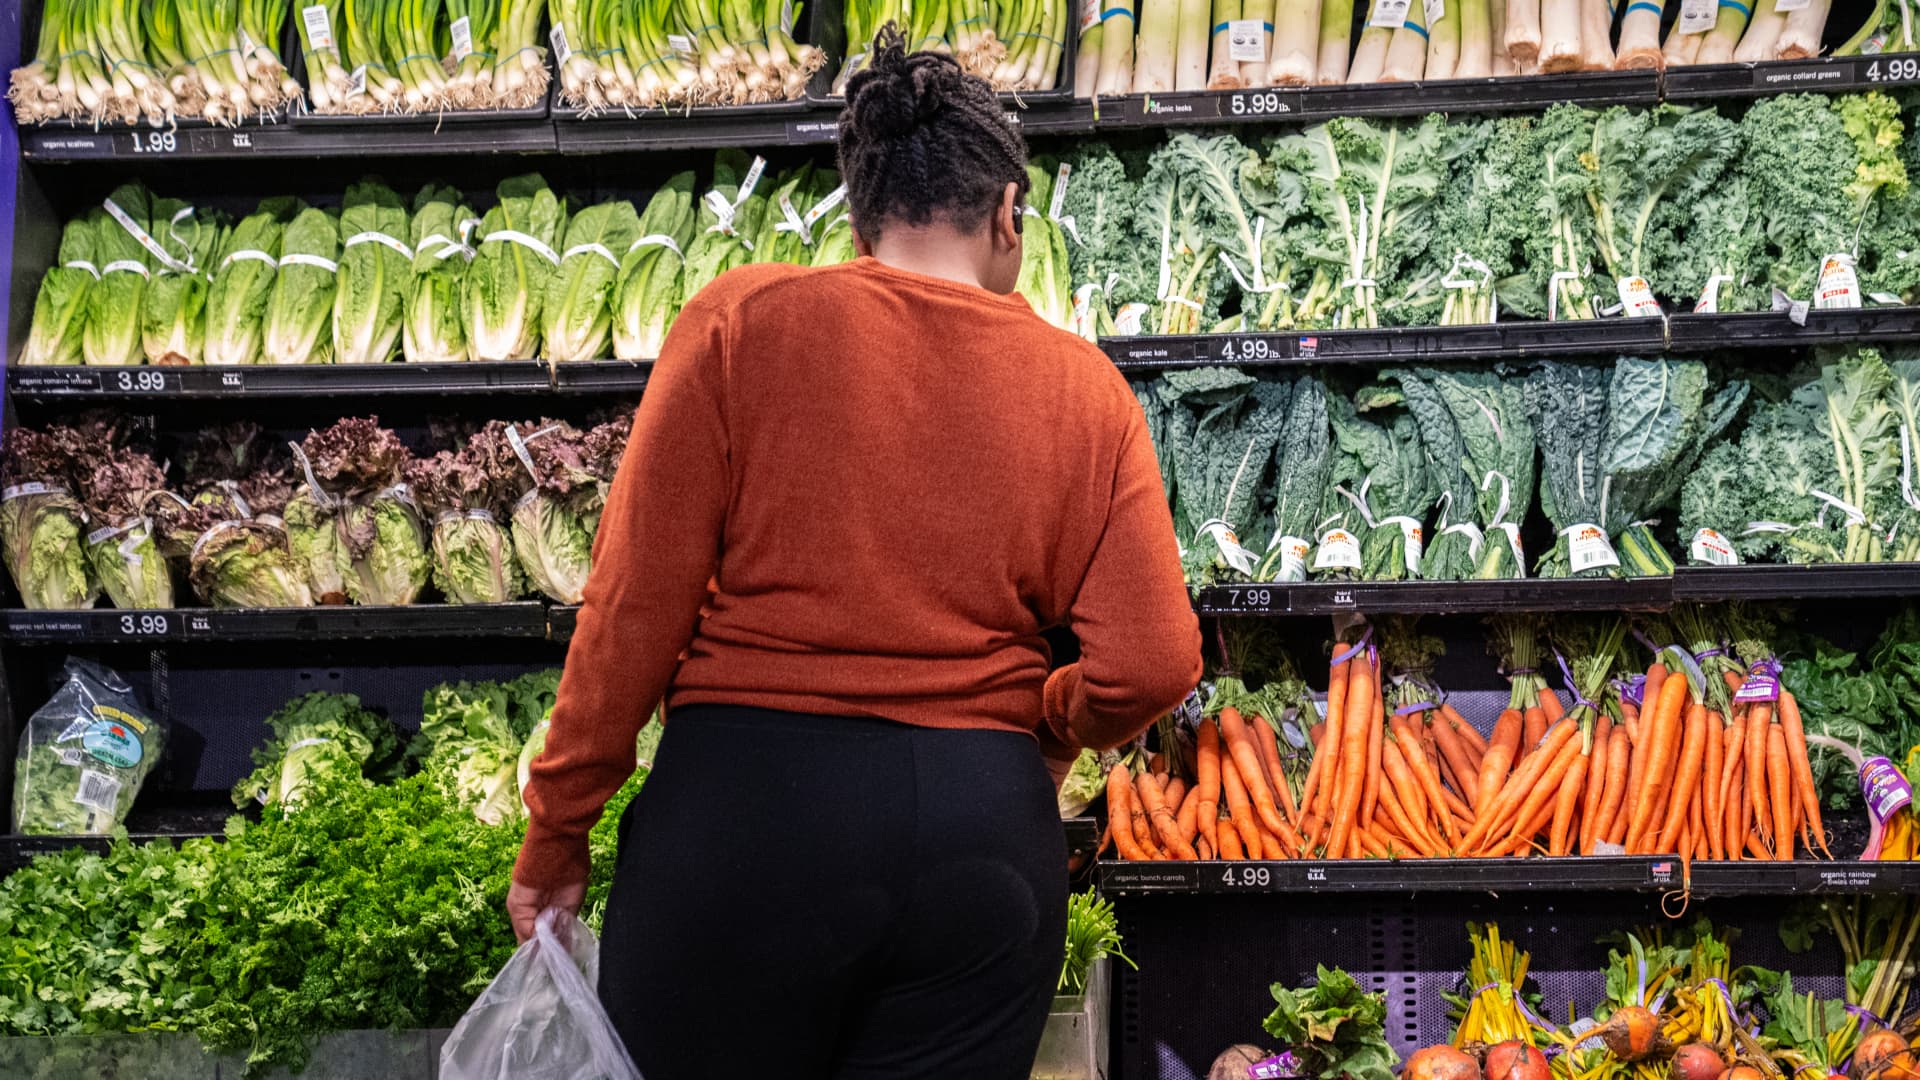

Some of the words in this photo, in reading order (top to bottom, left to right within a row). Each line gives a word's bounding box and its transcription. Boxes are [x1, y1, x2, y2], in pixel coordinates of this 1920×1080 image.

[1866, 59, 1917, 82] 4.99
[1766, 74, 1791, 82] organic
[1793, 72, 1816, 80] collard
[1818, 71, 1841, 80] greens
[1231, 93, 1278, 114] 5.99
[796, 124, 819, 132] organic
[42, 140, 66, 149] organic
[131, 132, 176, 152] 1.99
[1129, 350, 1153, 358] organic
[1154, 348, 1168, 357] kale
[1221, 340, 1268, 360] 4.99
[1268, 350, 1281, 359] lb.
[117, 371, 164, 390] 3.99
[1228, 589, 1271, 606] 7.99
[1334, 595, 1353, 603] U.S.A.
[59, 622, 82, 630] lettuce
[120, 614, 168, 634] 3.99
[1114, 874, 1139, 882] organic
[1140, 873, 1161, 881] bunch
[1162, 874, 1185, 882] carrots
[1222, 867, 1270, 886] 4.99
[1307, 872, 1327, 881] U.S.A.
[1820, 871, 1847, 879] organic
[1848, 870, 1877, 878] rainbow
[1849, 878, 1870, 886] chard
